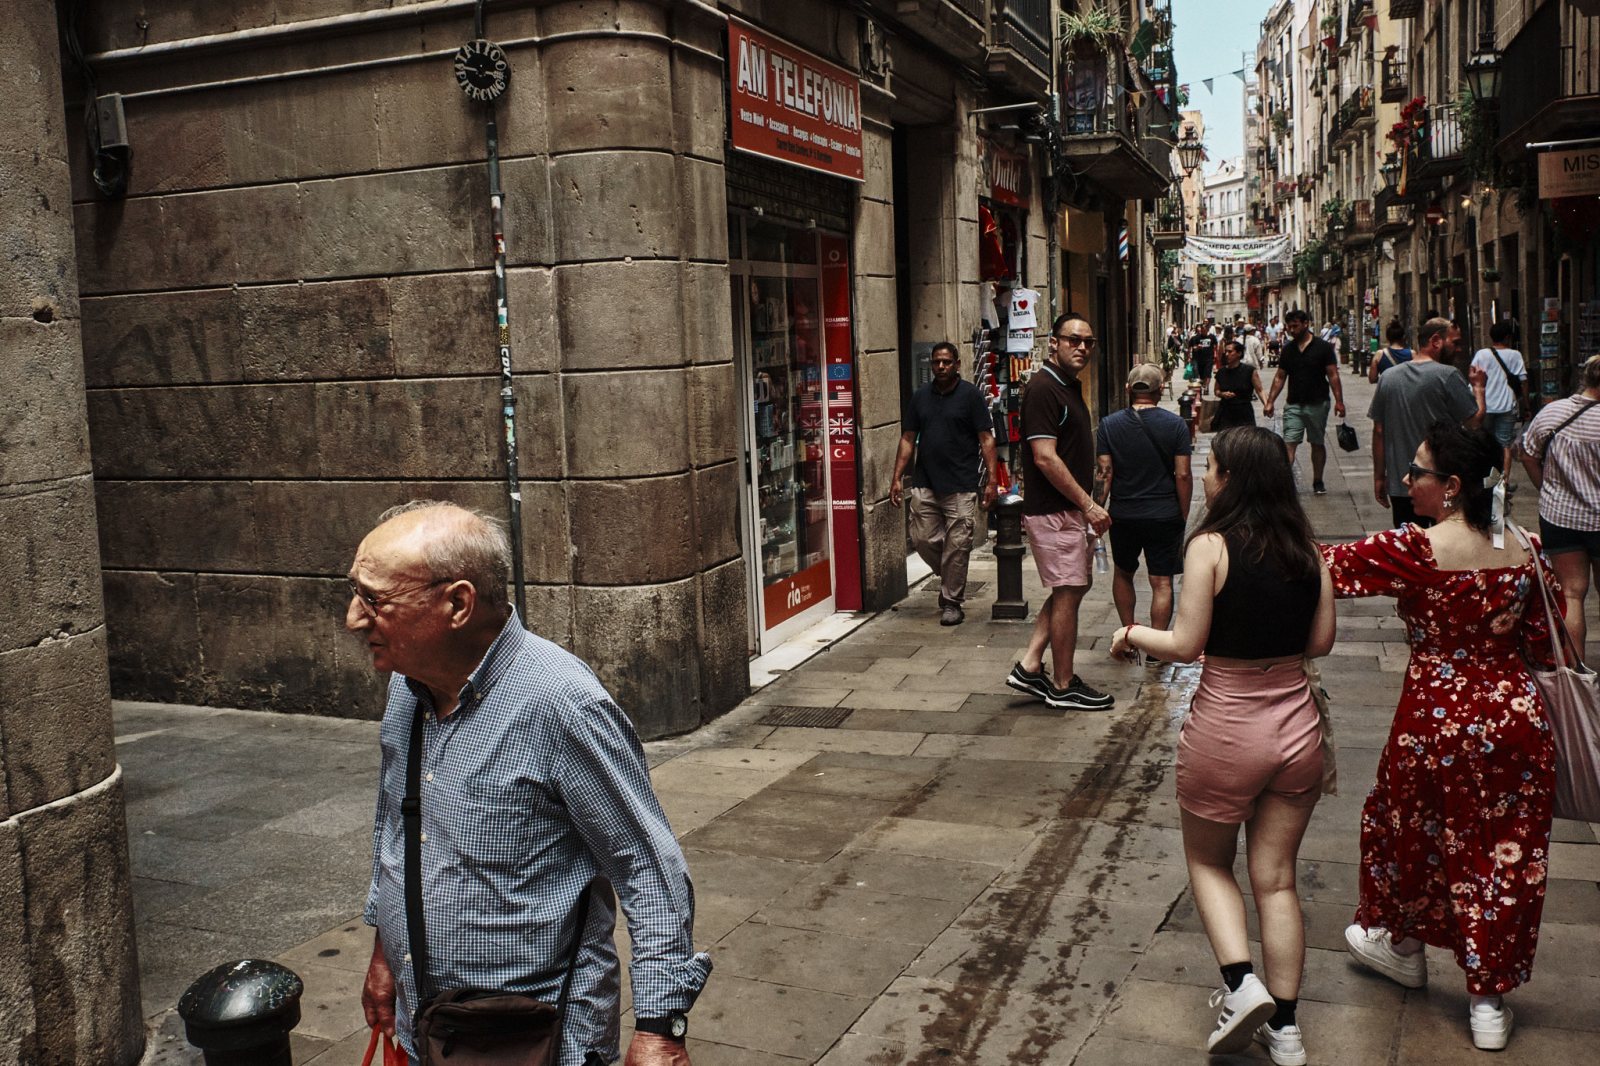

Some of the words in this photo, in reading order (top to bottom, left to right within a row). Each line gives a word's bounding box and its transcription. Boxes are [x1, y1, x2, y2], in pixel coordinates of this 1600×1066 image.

[455, 42, 507, 71] TATTOO
[456, 71, 506, 101] PIERCING
[737, 35, 769, 101] AM
[771, 49, 859, 134] TELEFONIA
[787, 581, 801, 609] ria
